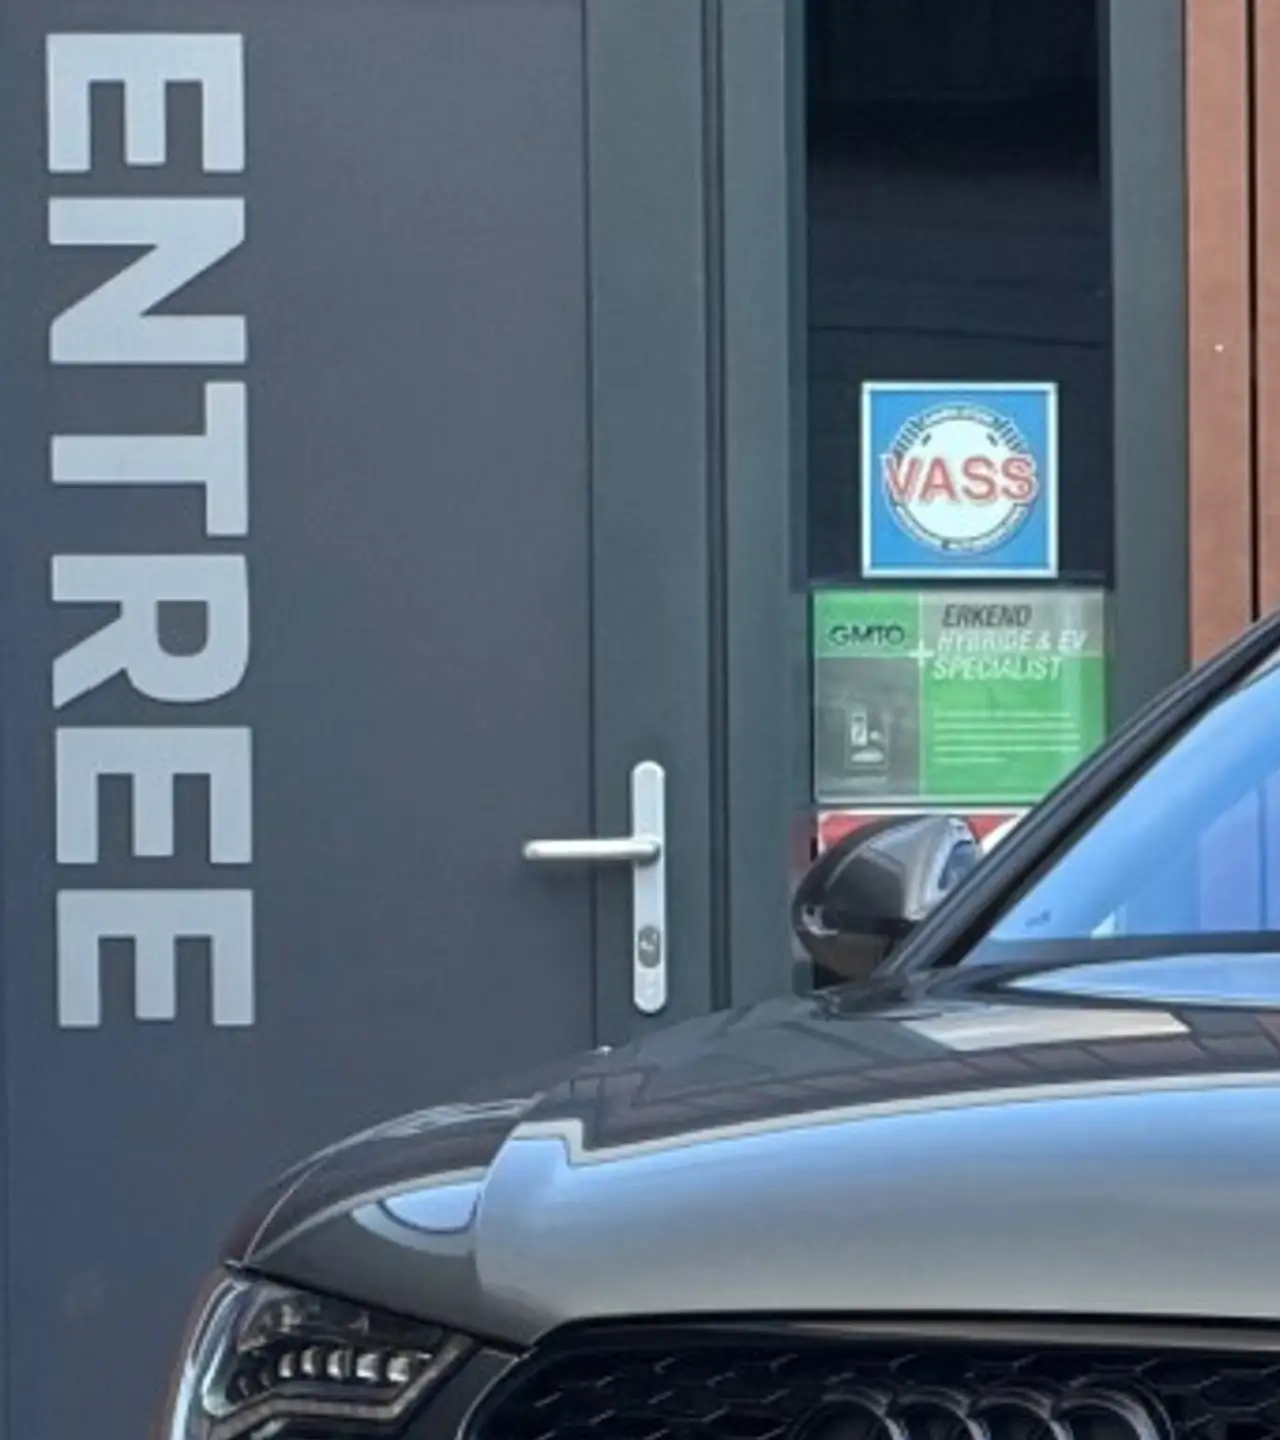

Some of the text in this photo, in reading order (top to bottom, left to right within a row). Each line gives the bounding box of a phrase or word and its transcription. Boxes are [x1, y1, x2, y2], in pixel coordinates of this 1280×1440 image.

[884, 455, 1037, 503] VASS
[46, 32, 254, 1027] ENTREE
[941, 604, 1033, 628] ERKEND
[937, 629, 1032, 652] HYBRIDE
[1057, 629, 1089, 652] EV
[932, 655, 1064, 681] SPECIALIST
